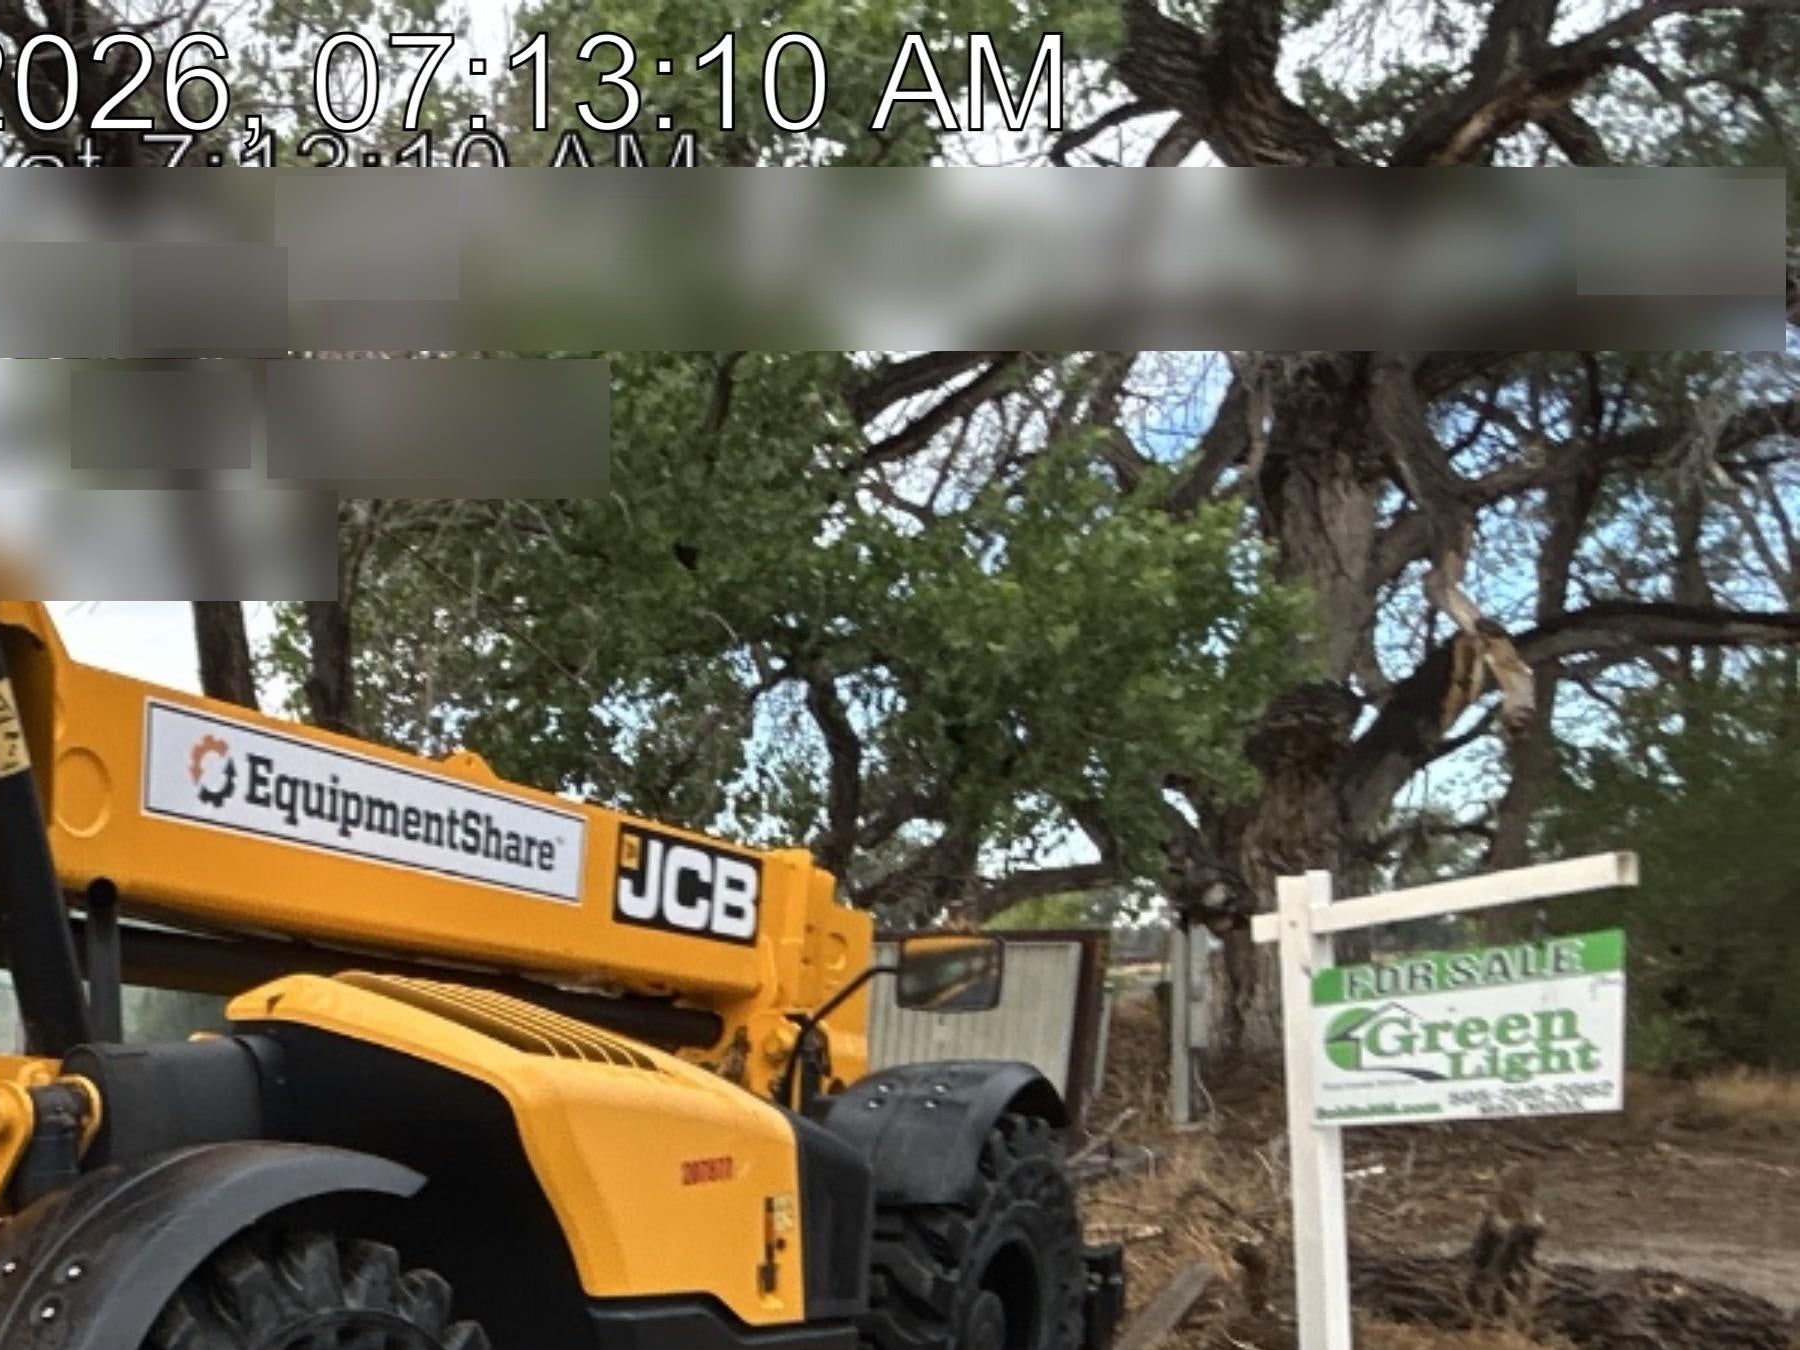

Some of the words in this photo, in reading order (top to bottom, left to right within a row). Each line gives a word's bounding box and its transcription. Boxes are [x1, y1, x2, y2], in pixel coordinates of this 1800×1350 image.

[244, 752, 556, 872] EquipmentShare
[617, 838, 759, 939] JCB
[1344, 960, 1438, 1000] FOR
[1445, 940, 1586, 989] SALE
[1364, 1007, 1580, 1058] Green
[1444, 1038, 1602, 1083] Light
